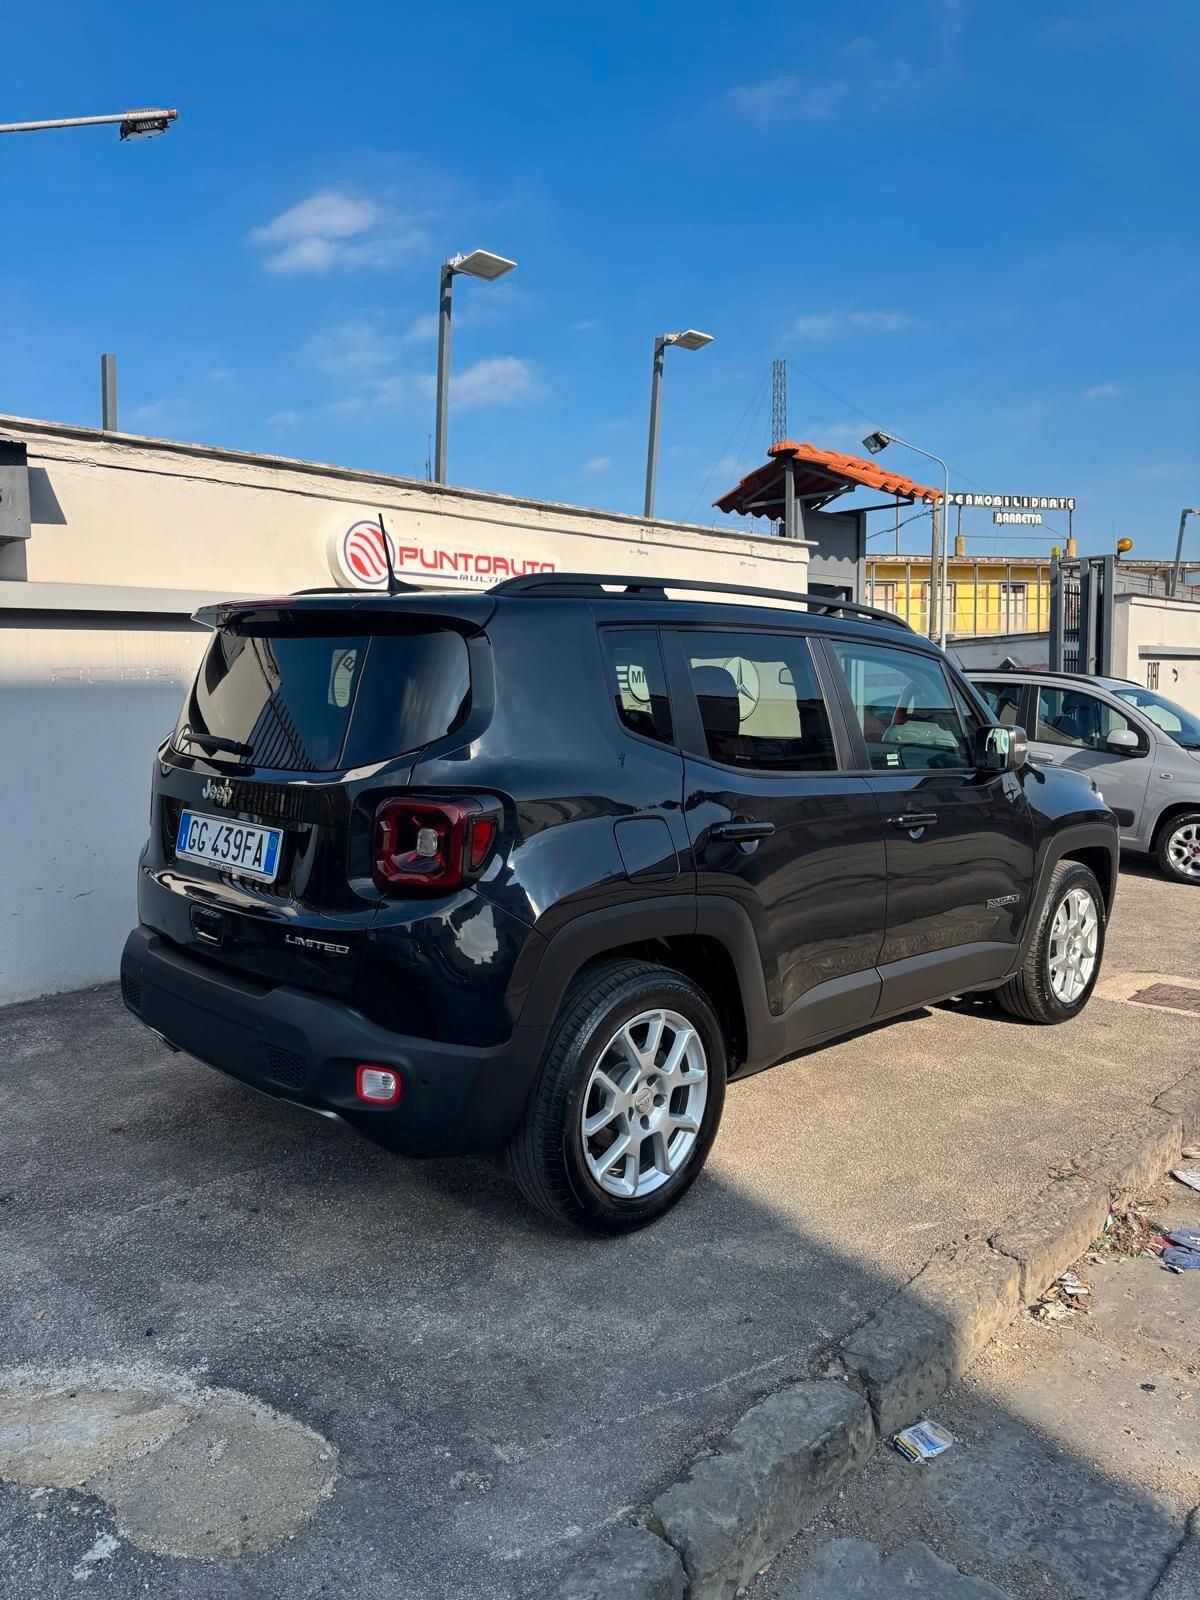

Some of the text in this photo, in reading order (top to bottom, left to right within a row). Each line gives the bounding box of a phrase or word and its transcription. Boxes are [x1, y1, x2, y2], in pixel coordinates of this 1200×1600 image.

[399, 546, 555, 576] PUNTOAUTO
[1146, 662, 1160, 690] FIAT
[202, 779, 232, 807] Jeep
[285, 934, 350, 954] LIMITED
